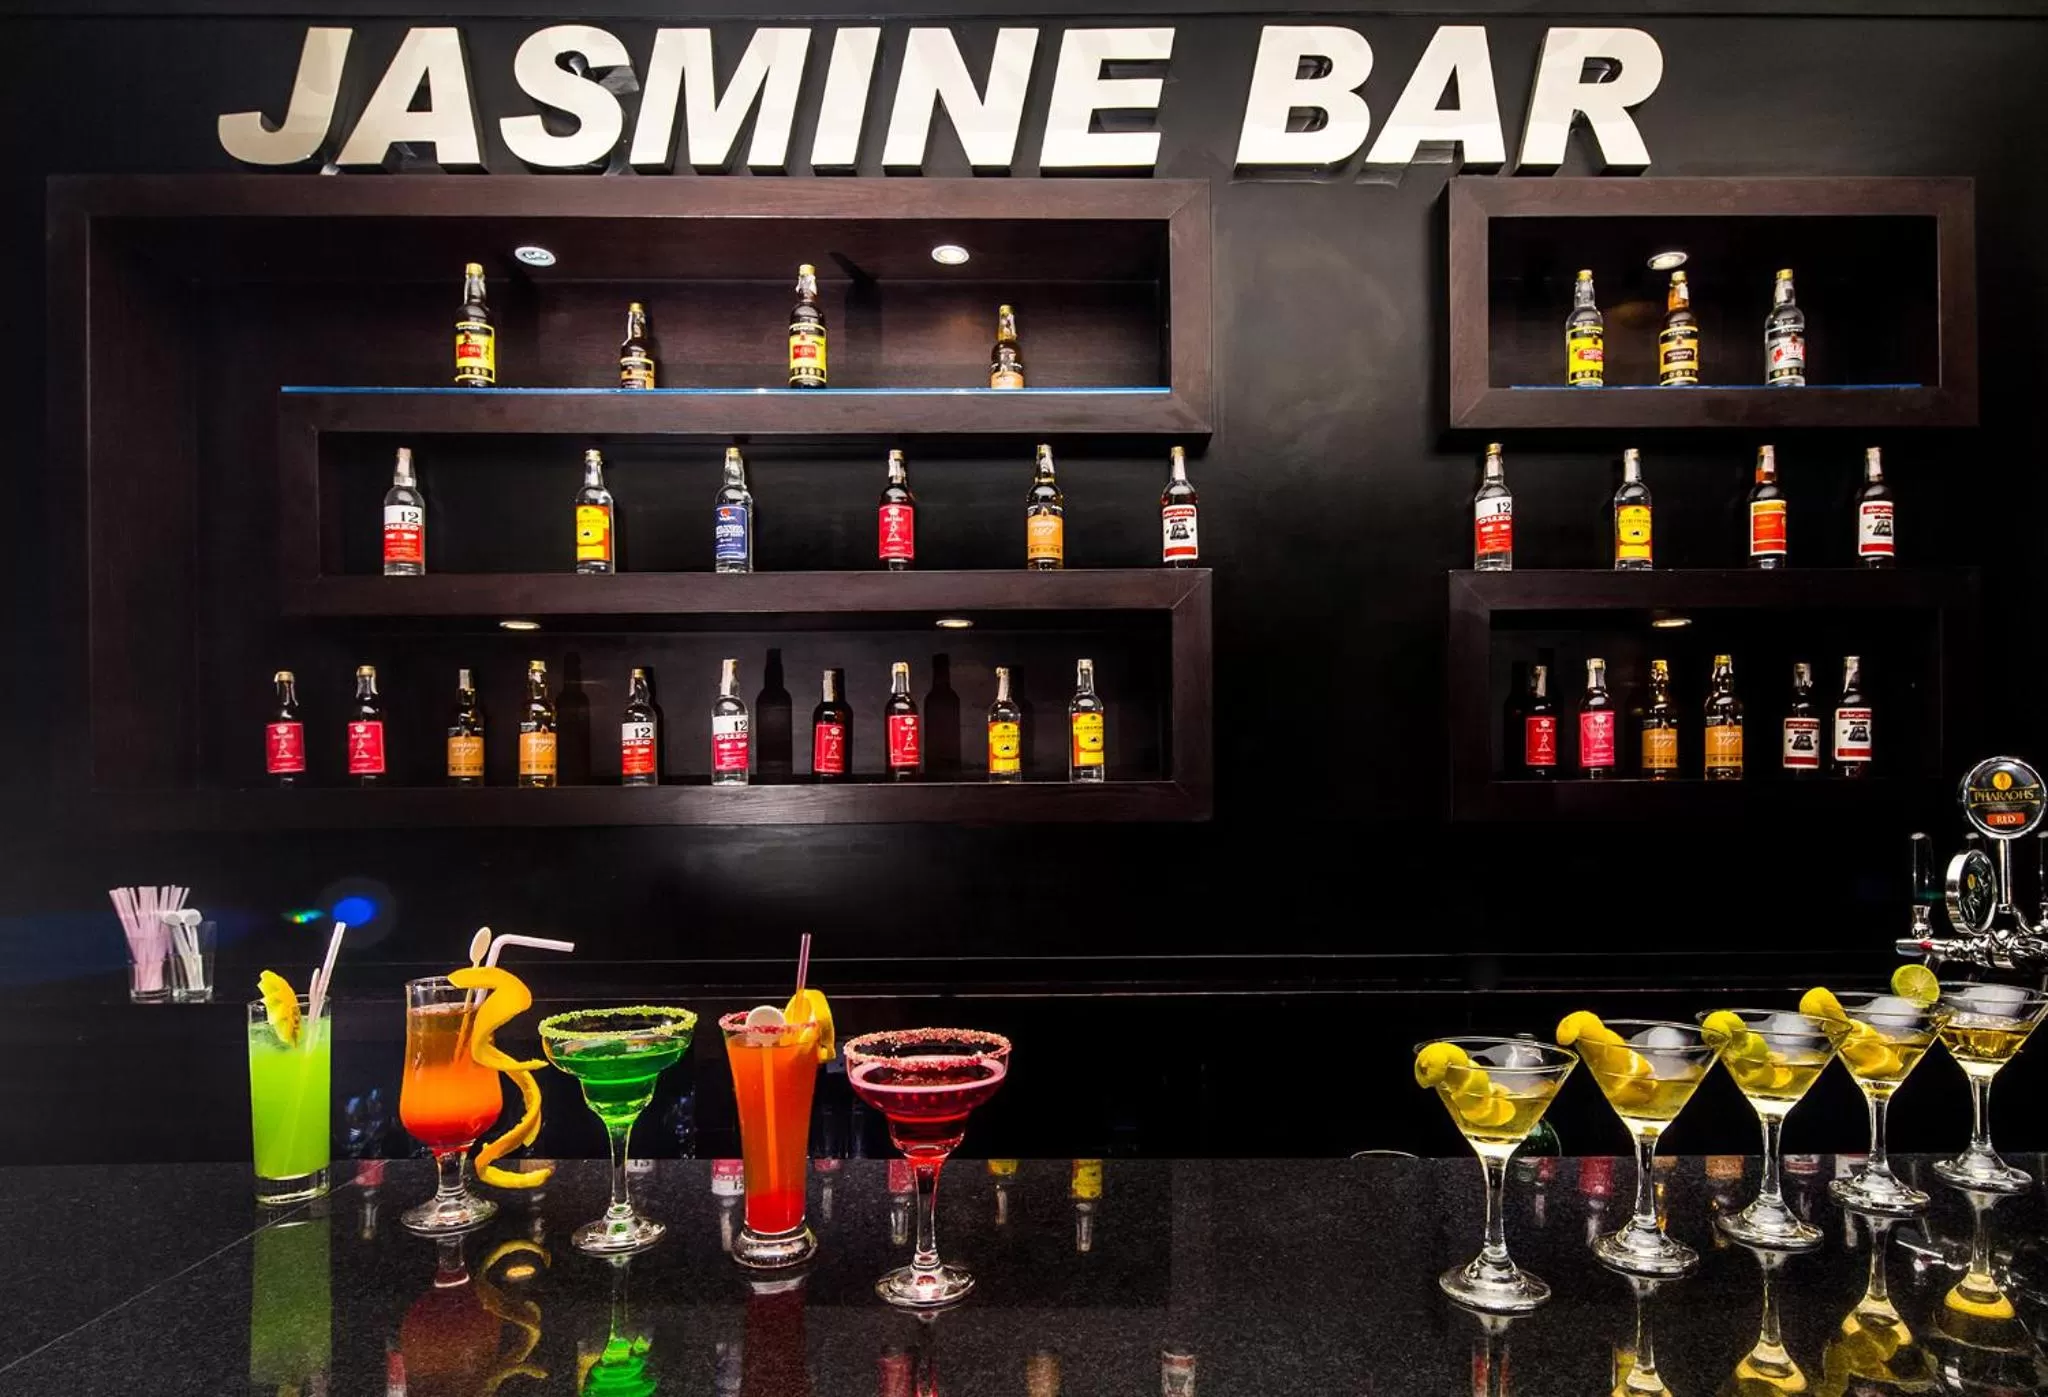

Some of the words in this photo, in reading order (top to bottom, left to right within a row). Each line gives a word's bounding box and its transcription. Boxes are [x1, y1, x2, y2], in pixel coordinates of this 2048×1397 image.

[217, 26, 1175, 168] JASMINE
[1235, 26, 1664, 168] BAR
[1497, 501, 1511, 513] 12
[400, 511, 419, 523] 12
[734, 719, 748, 731] 12
[634, 727, 651, 738] 12
[1974, 789, 2034, 802] PHARAOHS
[1996, 814, 2016, 825] RED
